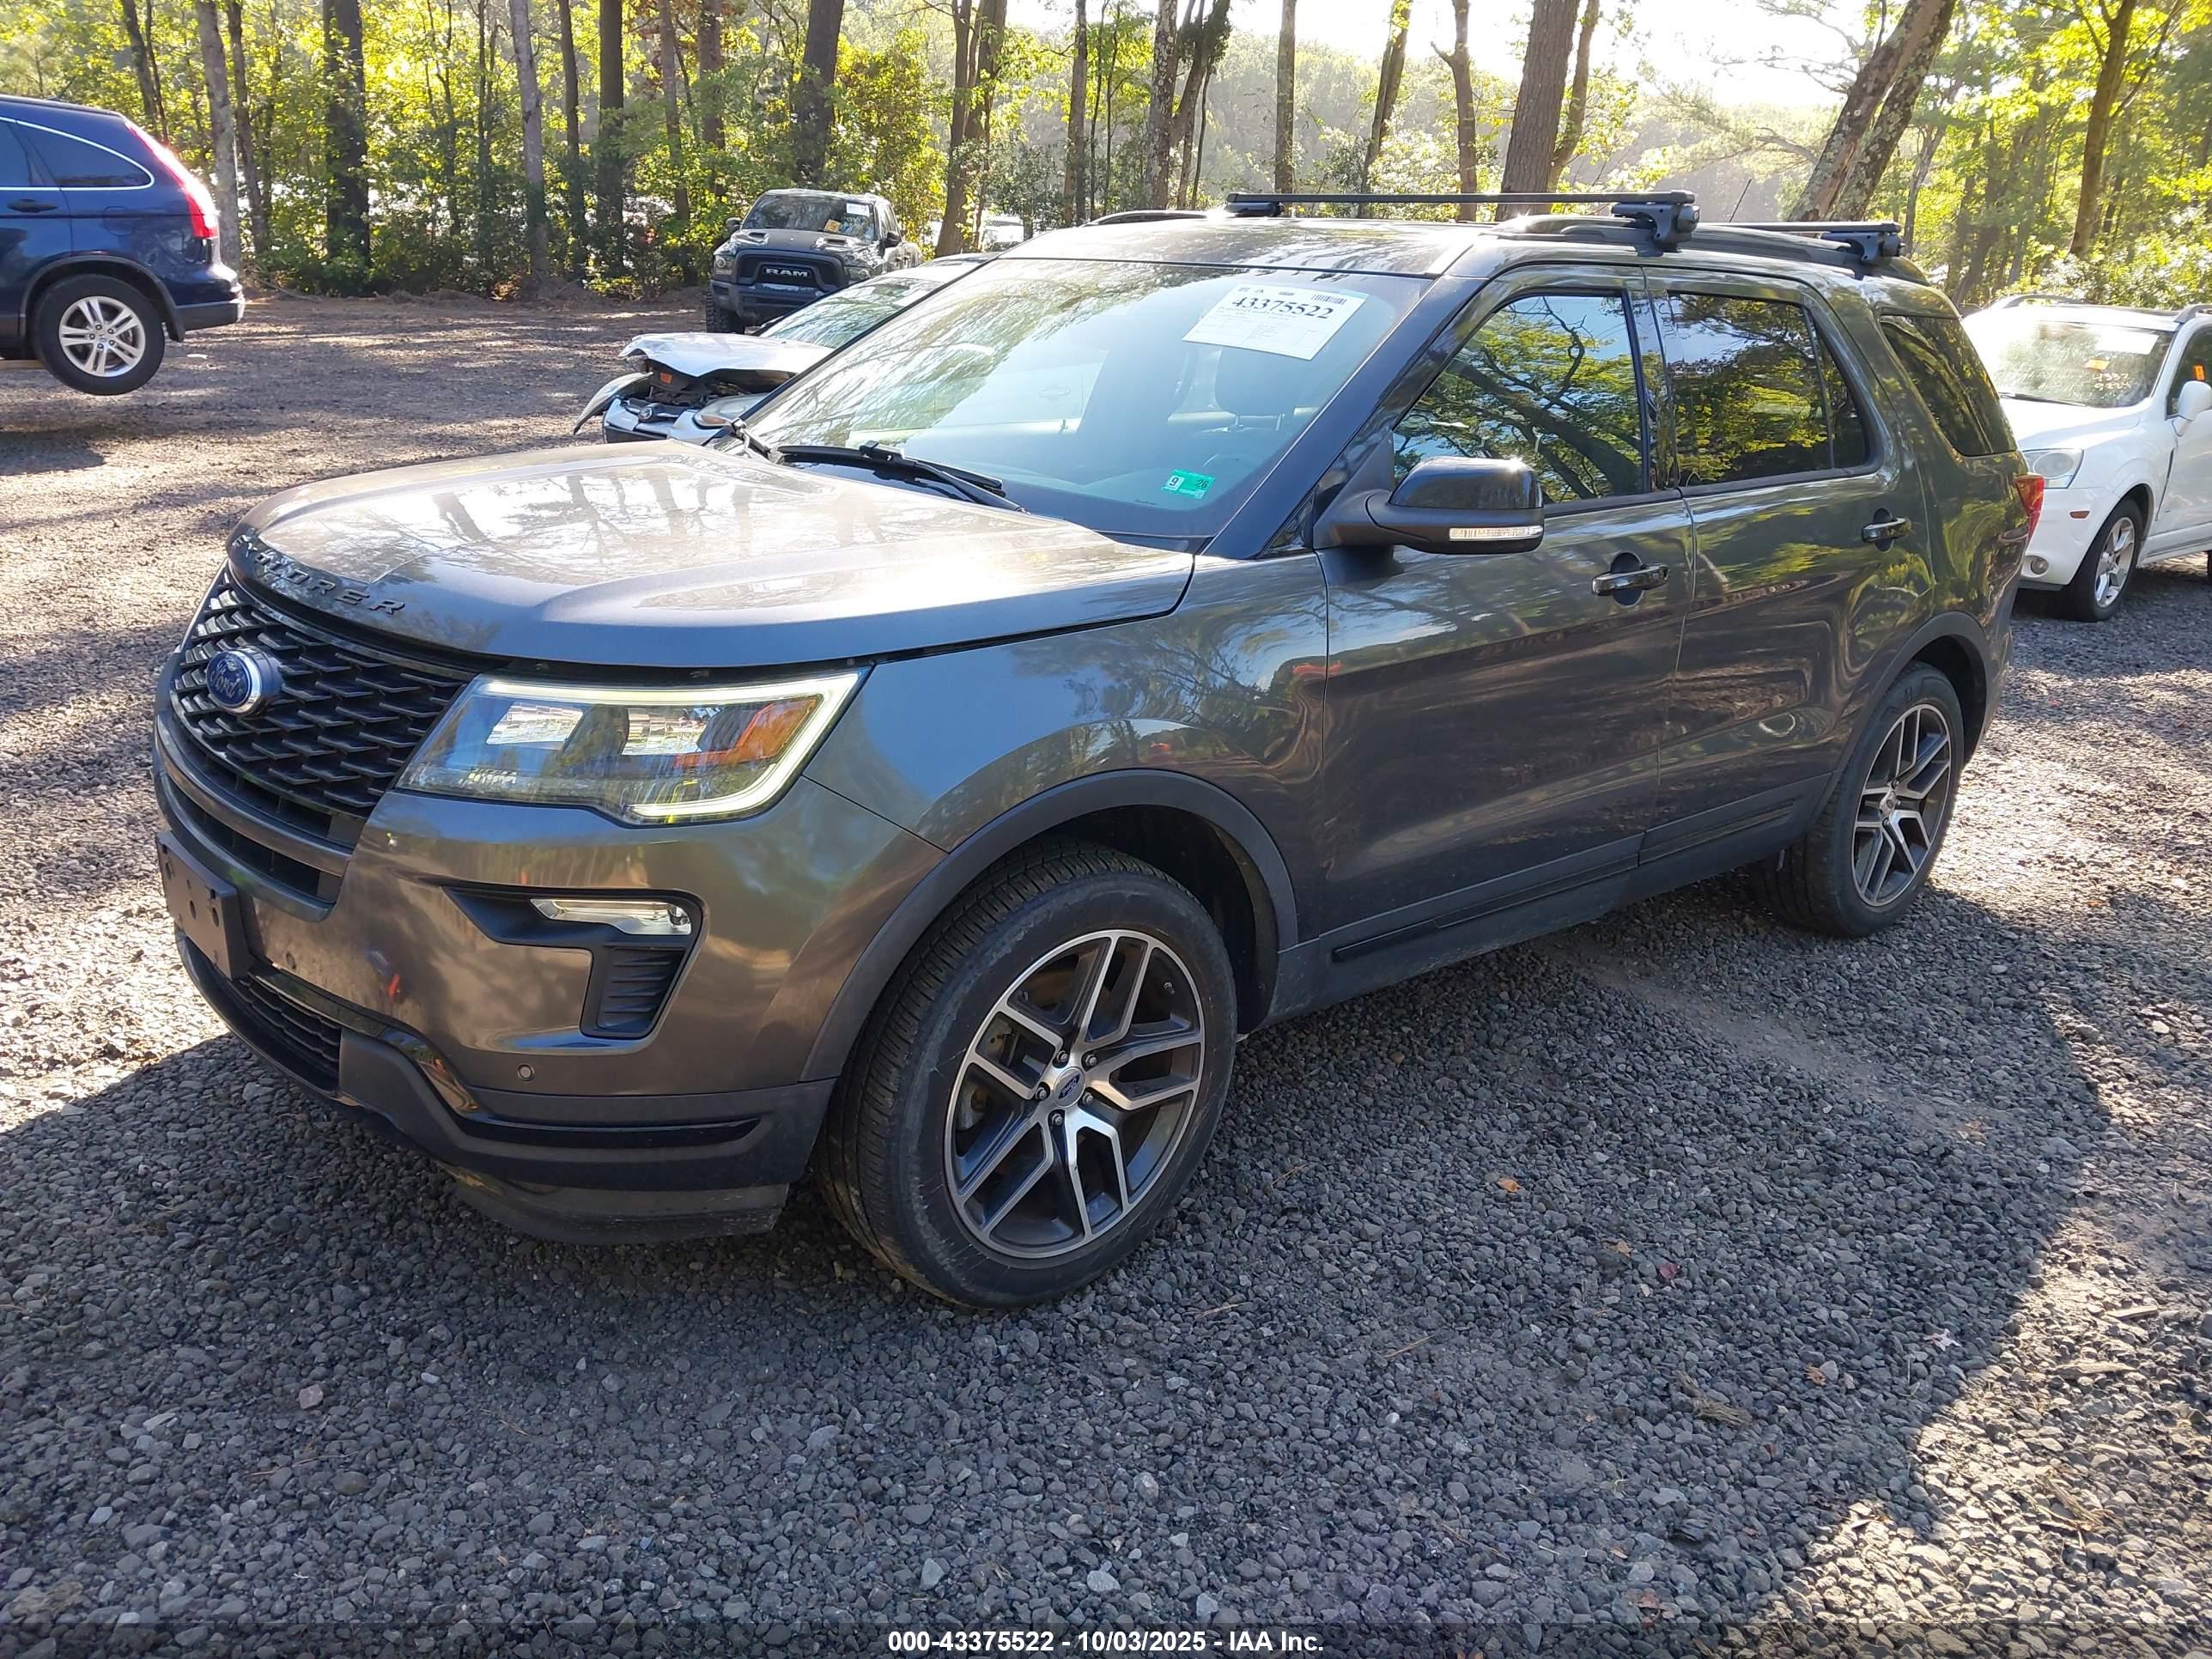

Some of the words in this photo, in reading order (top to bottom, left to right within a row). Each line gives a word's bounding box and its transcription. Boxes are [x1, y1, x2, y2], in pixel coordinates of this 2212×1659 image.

[765, 267, 810, 277] RAM
[1231, 296, 1334, 319] 43375522
[1169, 477, 1179, 486] 9
[210, 658, 241, 699] Ford
